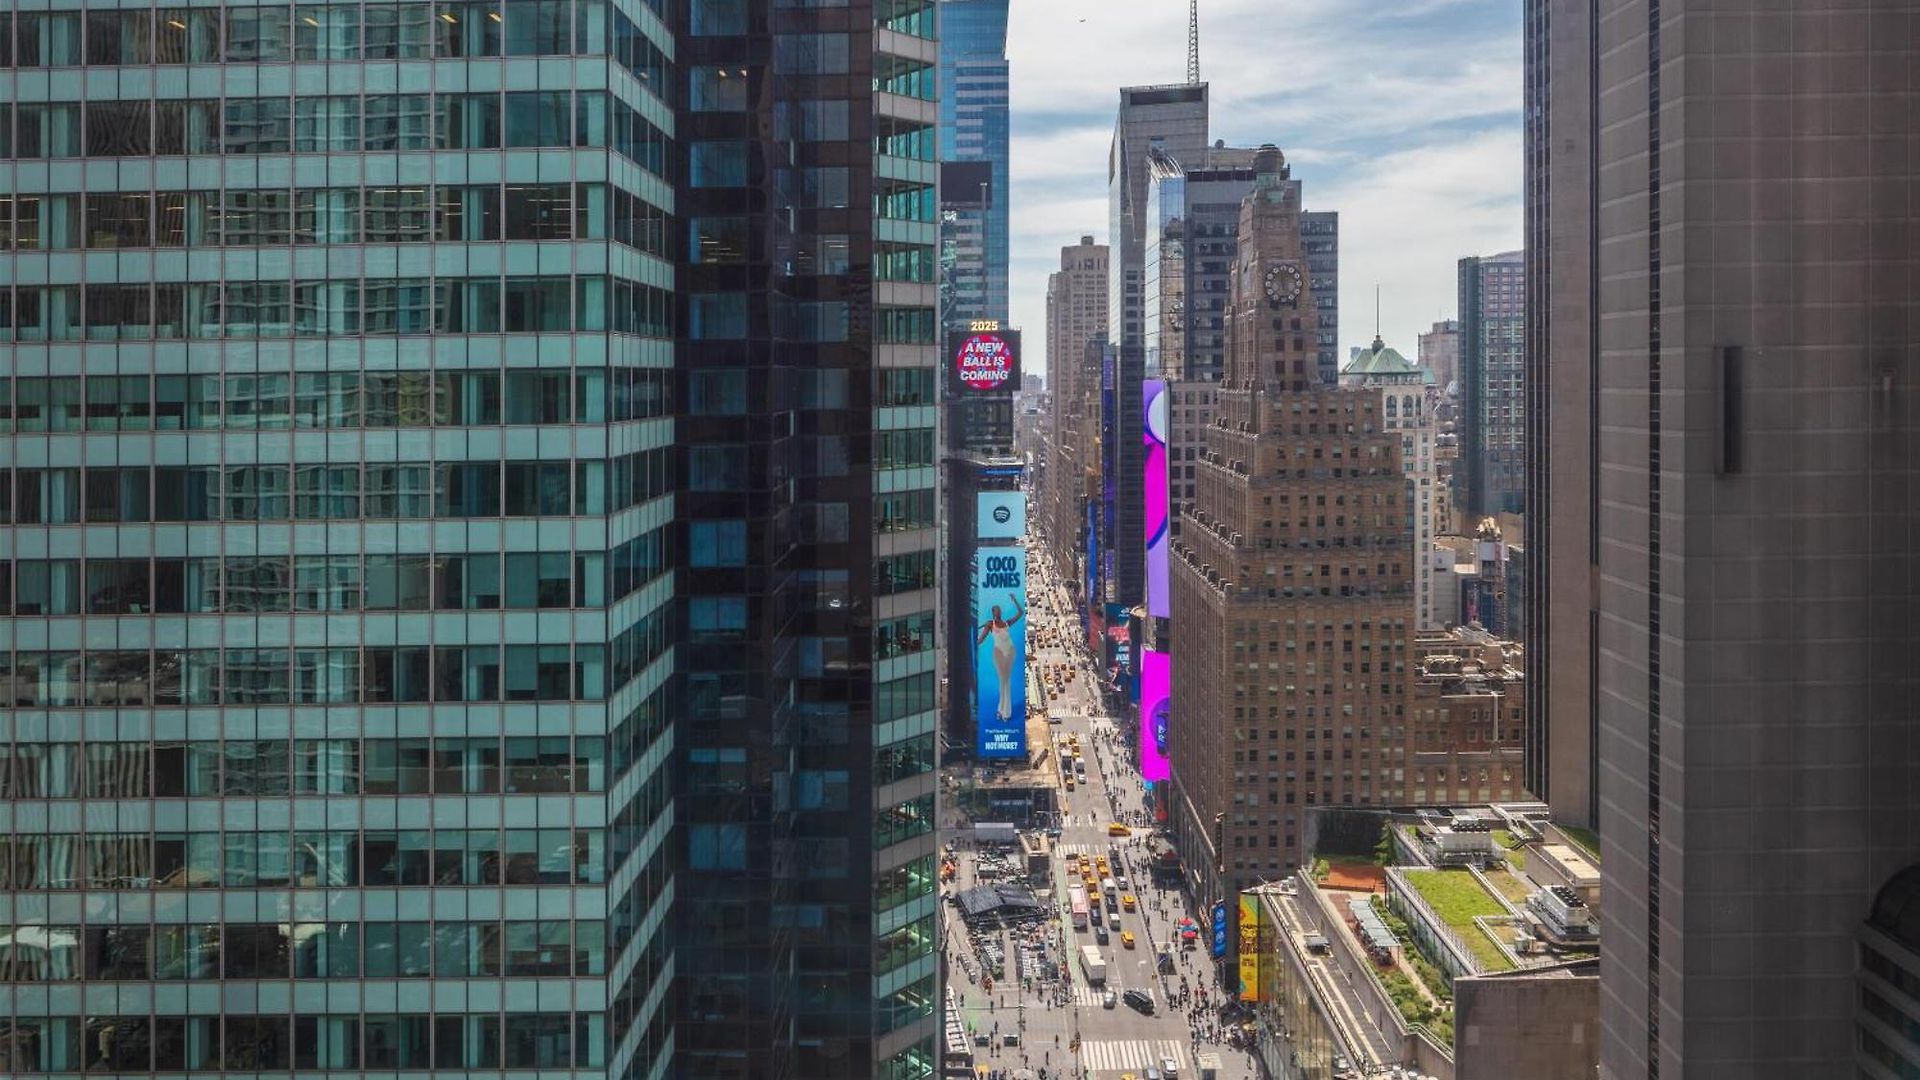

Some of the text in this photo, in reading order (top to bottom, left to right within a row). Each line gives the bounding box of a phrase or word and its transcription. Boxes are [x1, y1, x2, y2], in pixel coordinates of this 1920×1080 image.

[971, 321, 998, 331] 2025
[965, 342, 1004, 352] A NEW
[963, 356, 1005, 367] BALL IS
[960, 370, 1008, 381] COMING
[986, 556, 1017, 572] COCO
[982, 573, 1020, 588] JONES
